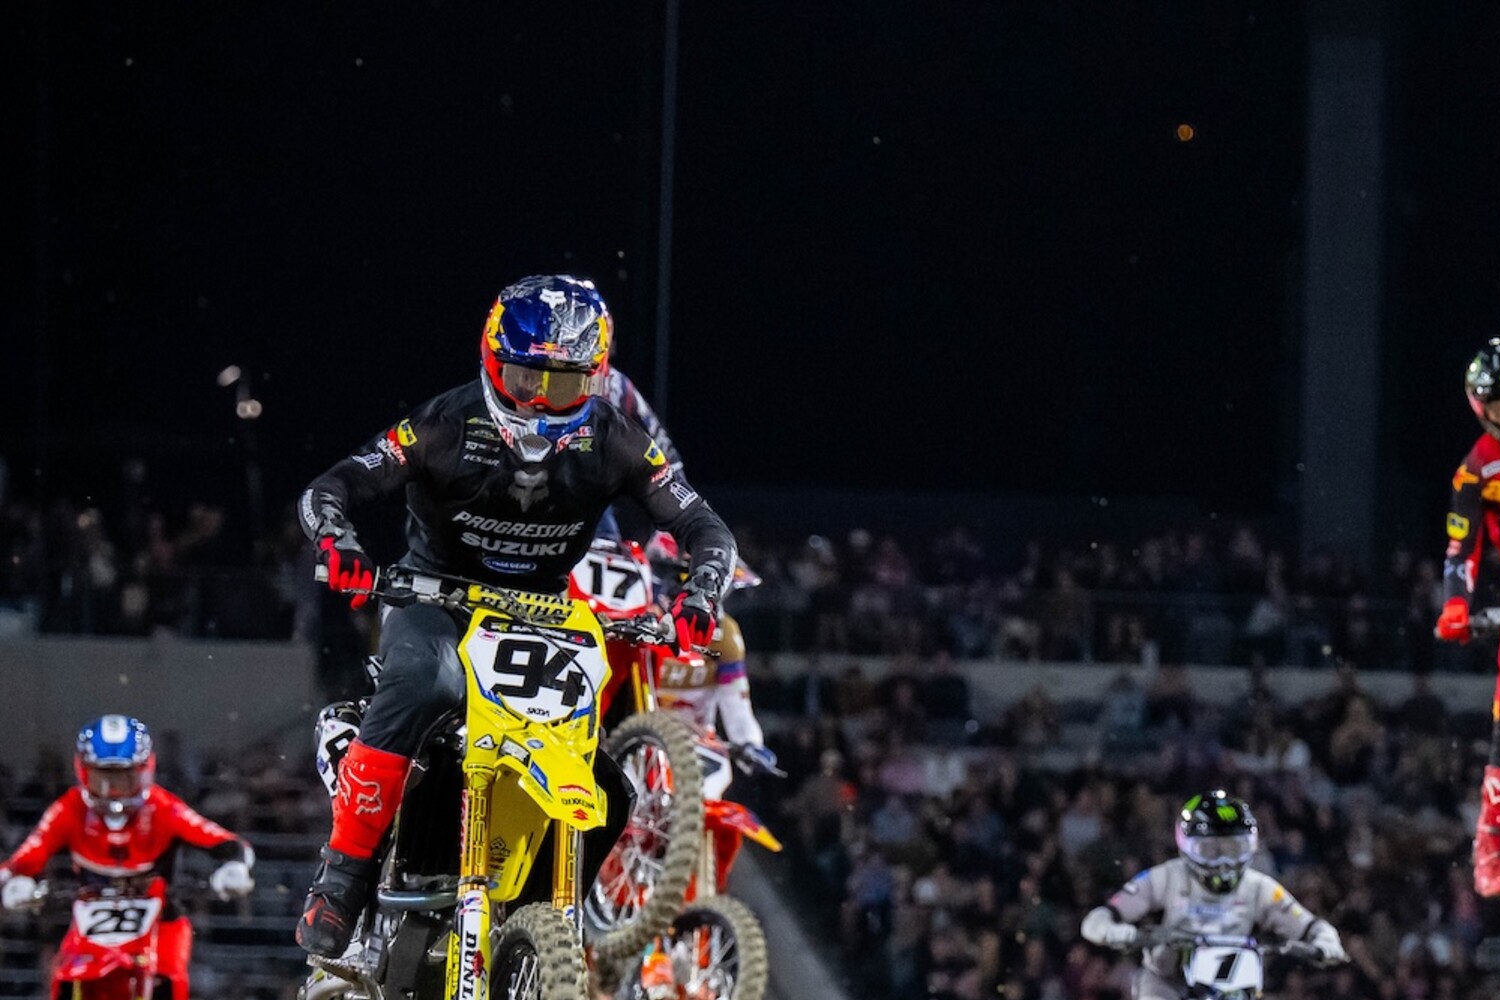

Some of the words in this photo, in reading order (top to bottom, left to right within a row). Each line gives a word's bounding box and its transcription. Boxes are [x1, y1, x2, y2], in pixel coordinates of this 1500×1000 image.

[452, 510, 585, 538] PROGRESSIVE
[460, 531, 568, 556] SUZUKI
[588, 560, 642, 600] 17
[489, 638, 588, 708] 94
[86, 907, 148, 936] 28
[1214, 952, 1242, 983] 1
